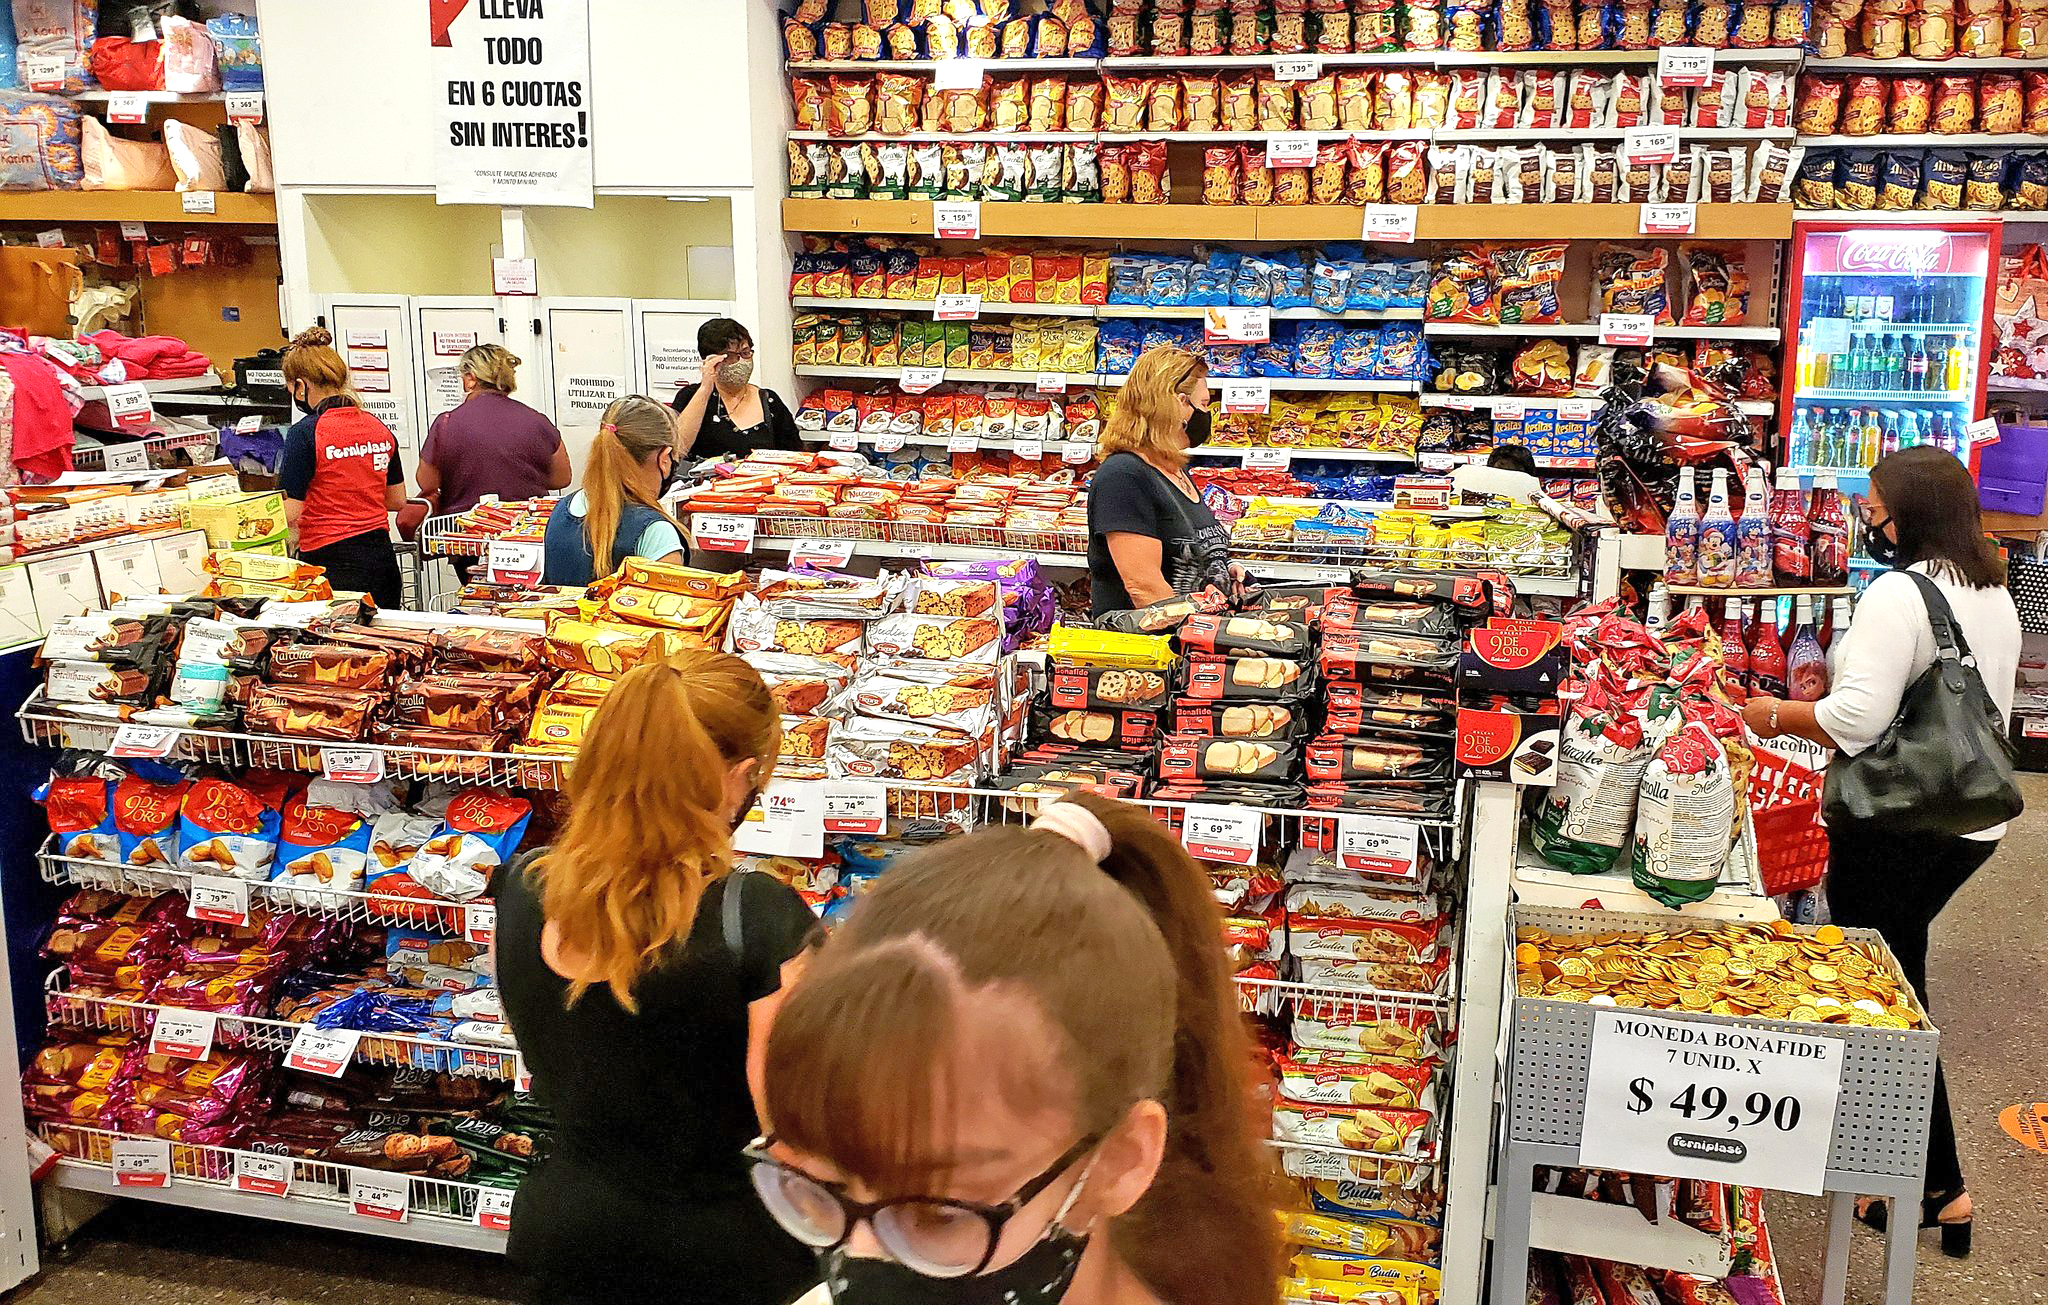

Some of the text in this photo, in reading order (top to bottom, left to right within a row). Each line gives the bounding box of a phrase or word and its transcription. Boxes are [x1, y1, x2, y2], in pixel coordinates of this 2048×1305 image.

[480, 0, 544, 20] LLEVA
[484, 38, 542, 65] TODO
[1279, 64, 1306, 73] $ 139
[1669, 60, 1698, 69] $ 119
[448, 80, 582, 107] EN 6 CUOTAS
[450, 112, 588, 148] SIN INTERES!
[1288, 144, 1302, 152] 199
[1636, 138, 1664, 148] $ 169
[504, 170, 528, 178] TARJETAS
[941, 214, 966, 222] $ 159
[1664, 212, 1680, 220] 179
[1372, 218, 1400, 226] $ 159
[1609, 322, 1638, 331] $ 199
[570, 378, 614, 388] PROHIBIDO
[568, 390, 604, 398] UTILIZAR
[1232, 390, 1256, 398] $ 79
[115, 396, 139, 407] $ 899
[362, 401, 396, 410] OHIBIDO
[570, 400, 610, 410] PROBADO
[390, 412, 398, 420] EL
[326, 440, 392, 460] Ferniplast
[114, 458, 120, 466] $
[1573, 482, 1598, 495] Saladix
[849, 490, 882, 498] Nucrem
[702, 522, 735, 532] $ 159
[1490, 636, 1518, 656] 9 DE
[1502, 646, 1528, 656] ORO
[1190, 654, 1226, 663] Bonafide
[1176, 708, 1212, 716] Bonafide
[138, 732, 151, 740] 129
[1464, 734, 1490, 756] 9 DE
[1476, 745, 1500, 754] ORO
[344, 756, 354, 764] 99
[204, 786, 222, 810] 9
[774, 796, 787, 807] 74
[124, 796, 160, 818] 9 DE
[474, 796, 494, 812] DE
[828, 802, 856, 810] $ 74
[132, 809, 166, 824] ORO
[464, 808, 494, 828] ORO
[308, 818, 338, 835] ORO
[1192, 822, 1198, 831] $
[1210, 825, 1222, 833] 69
[1348, 837, 1354, 846] $
[1366, 839, 1379, 848] 69
[196, 892, 220, 902] $ 79
[1356, 906, 1398, 918] Budín
[1401, 911, 1420, 920] Gaona
[474, 916, 478, 924] $
[1320, 928, 1342, 937] Gaona
[1304, 939, 1346, 950] Budín
[1318, 967, 1360, 978] Budín
[1326, 1019, 1349, 1028] Gaona
[174, 1029, 184, 1037] 49
[300, 1038, 325, 1050] $ 49
[1614, 1018, 1828, 1060] MONEDA BONAFIDE
[1667, 1049, 1763, 1076] 7 UNID. X
[1316, 1074, 1338, 1083] Gaona
[1300, 1086, 1343, 1098] Budín
[1626, 1076, 1802, 1134] $ 49,90
[1304, 1109, 1326, 1119] Gaona
[1672, 1136, 1744, 1158] Ferniplast
[133, 1160, 142, 1168] 49
[244, 1161, 268, 1172] $ 44
[1338, 1180, 1384, 1200] Budín
[358, 1190, 362, 1198] $
[371, 1192, 381, 1201] 44
[486, 1198, 510, 1209] $ 44
[1369, 1266, 1400, 1278] Budín
